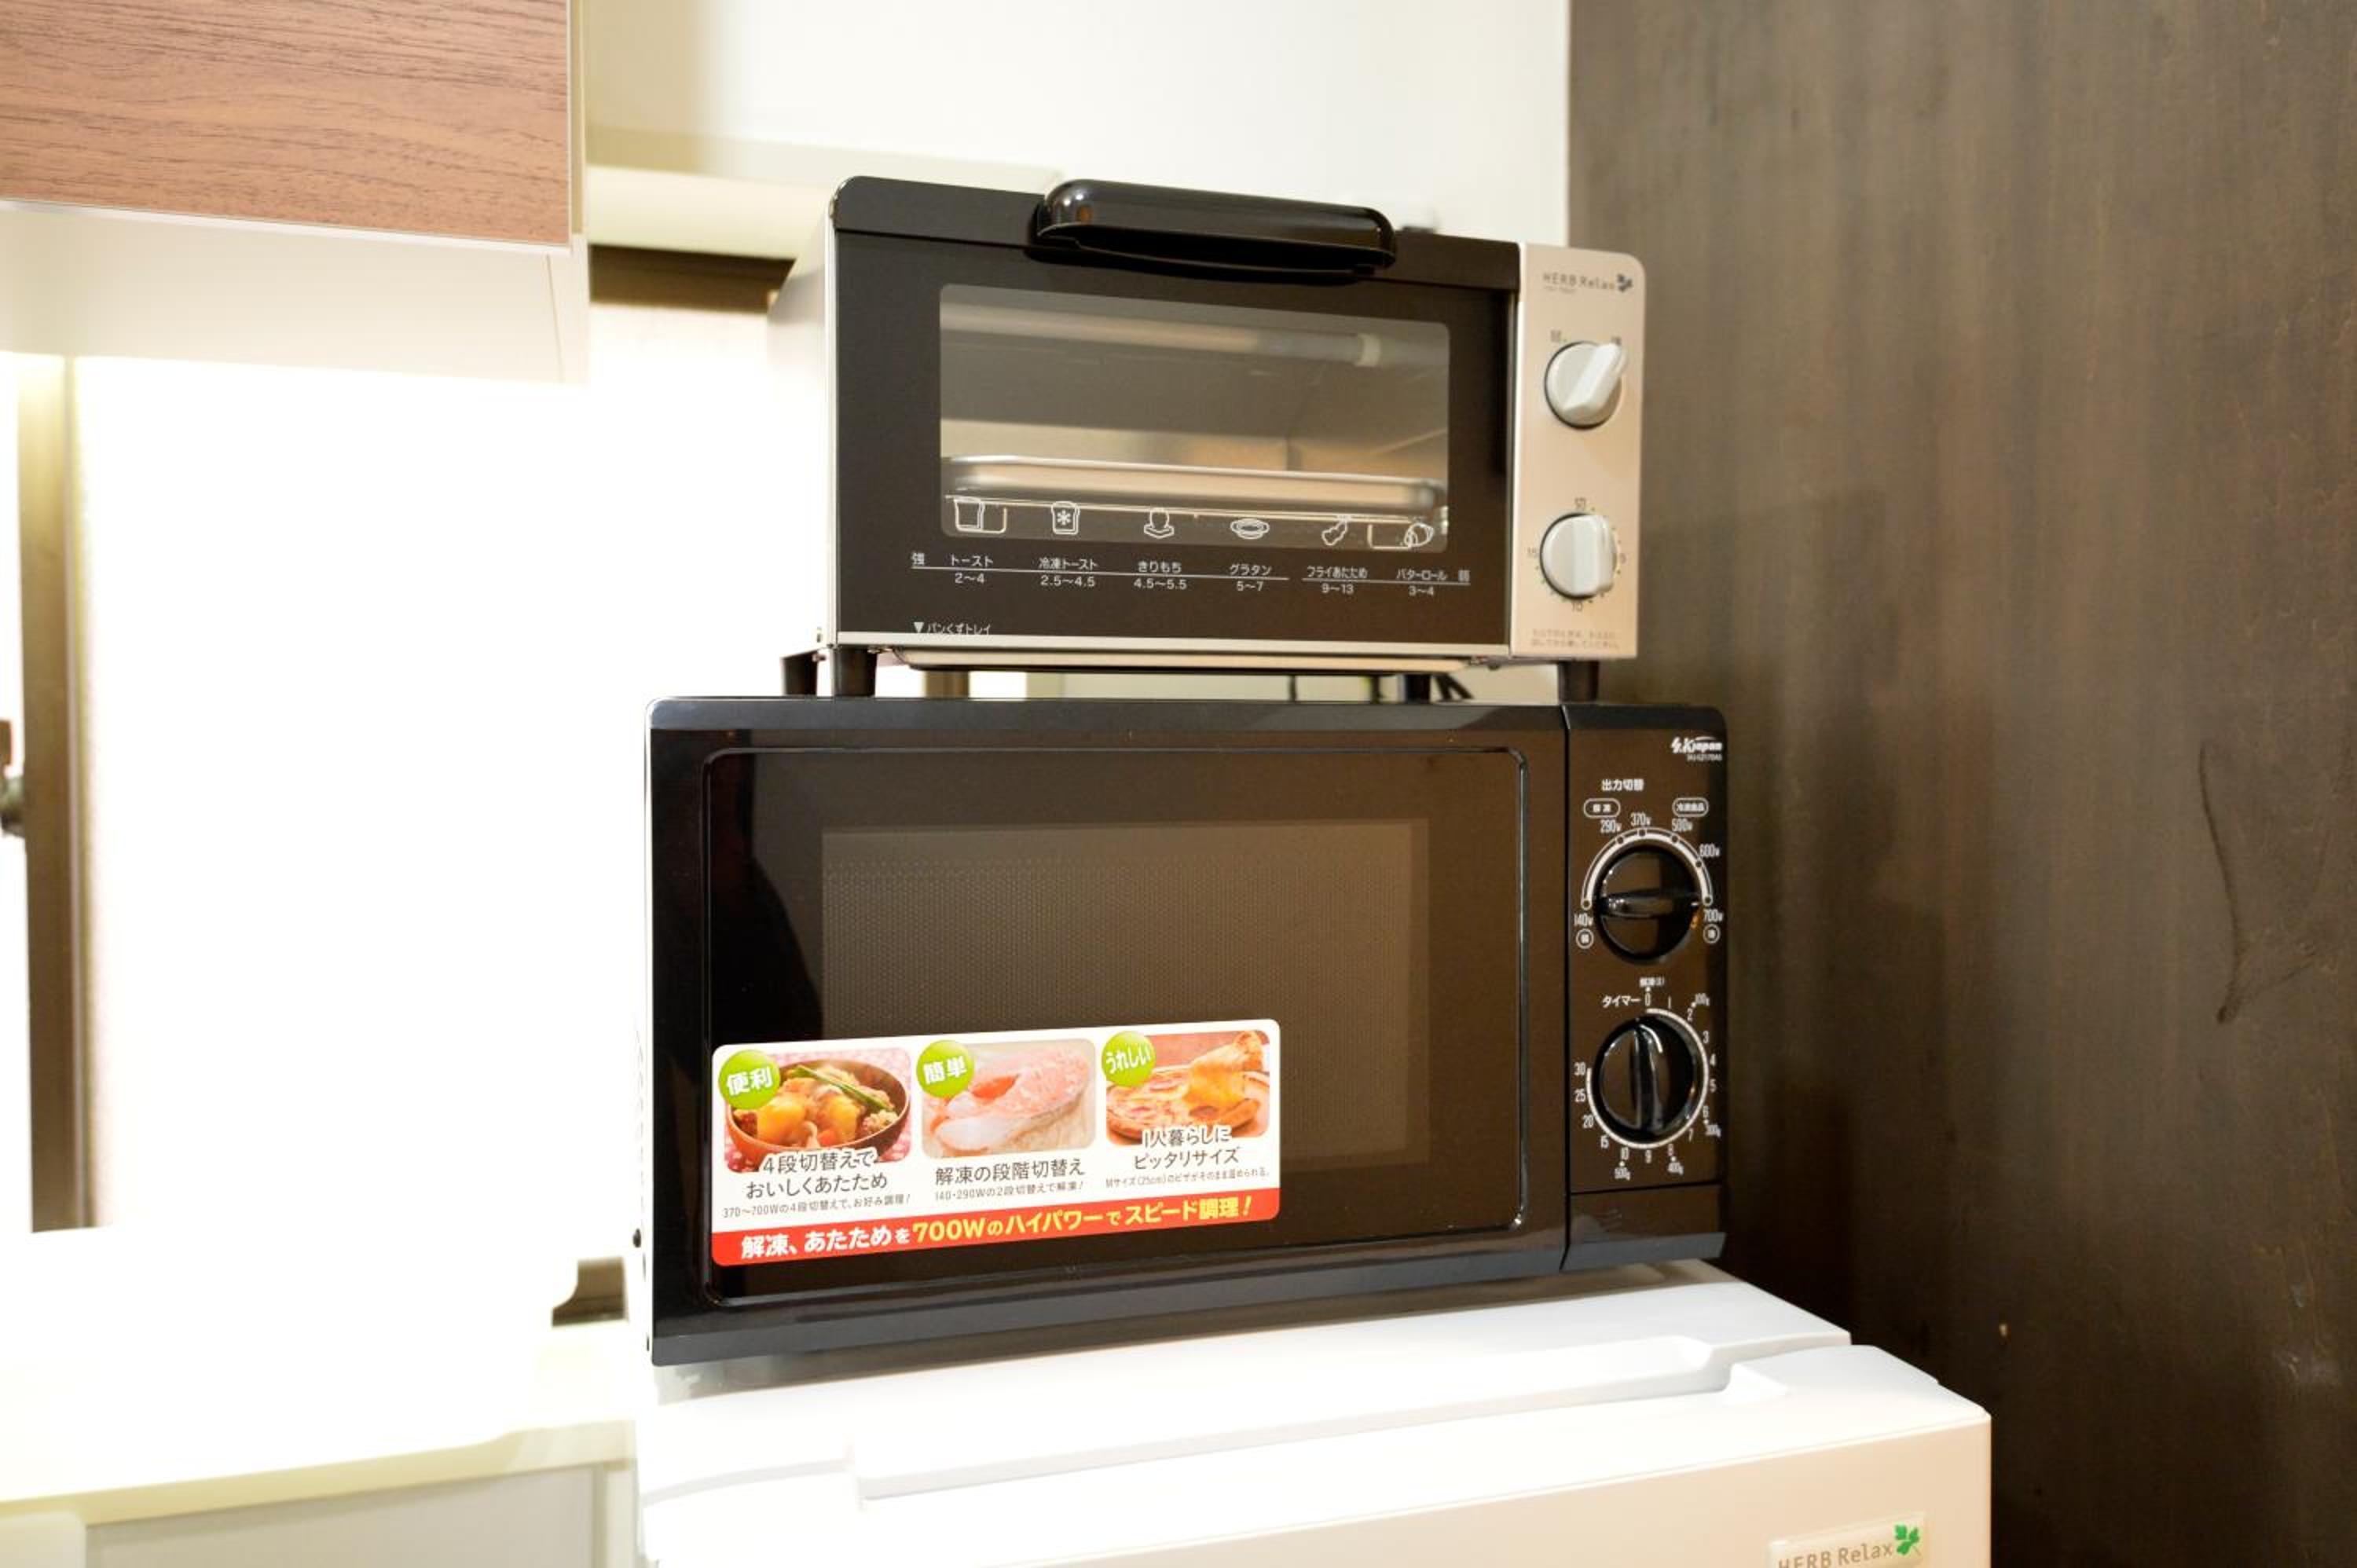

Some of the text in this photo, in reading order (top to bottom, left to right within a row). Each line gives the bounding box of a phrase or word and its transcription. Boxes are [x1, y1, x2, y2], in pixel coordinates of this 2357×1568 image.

[951, 555, 993, 566] トースト
[1039, 557, 1098, 570] 冷凍トースト
[1138, 561, 1182, 573] きりもち
[1230, 563, 1272, 576] グラタン
[1602, 995, 1640, 1008] タイマー
[1687, 1008, 1694, 1021] 2
[1703, 1030, 1710, 1044] 3
[1106, 1042, 1151, 1074] うれしい
[1574, 1062, 1585, 1075] 30
[1709, 1053, 1717, 1066] 4
[923, 1055, 967, 1084] 簡単
[726, 1066, 773, 1096] 便利
[1574, 1090, 1585, 1102] 25
[1583, 1115, 1593, 1128] 20
[1145, 1127, 1230, 1148] 1人暮らしに
[763, 1151, 875, 1174] 4段切替えで
[1135, 1146, 1241, 1170] ピッタリサイズ
[935, 1158, 1085, 1185] 解凍の段階切替え
[746, 1172, 888, 1200] おいしくあたため
[1838, 1541, 1893, 1566] Relax
